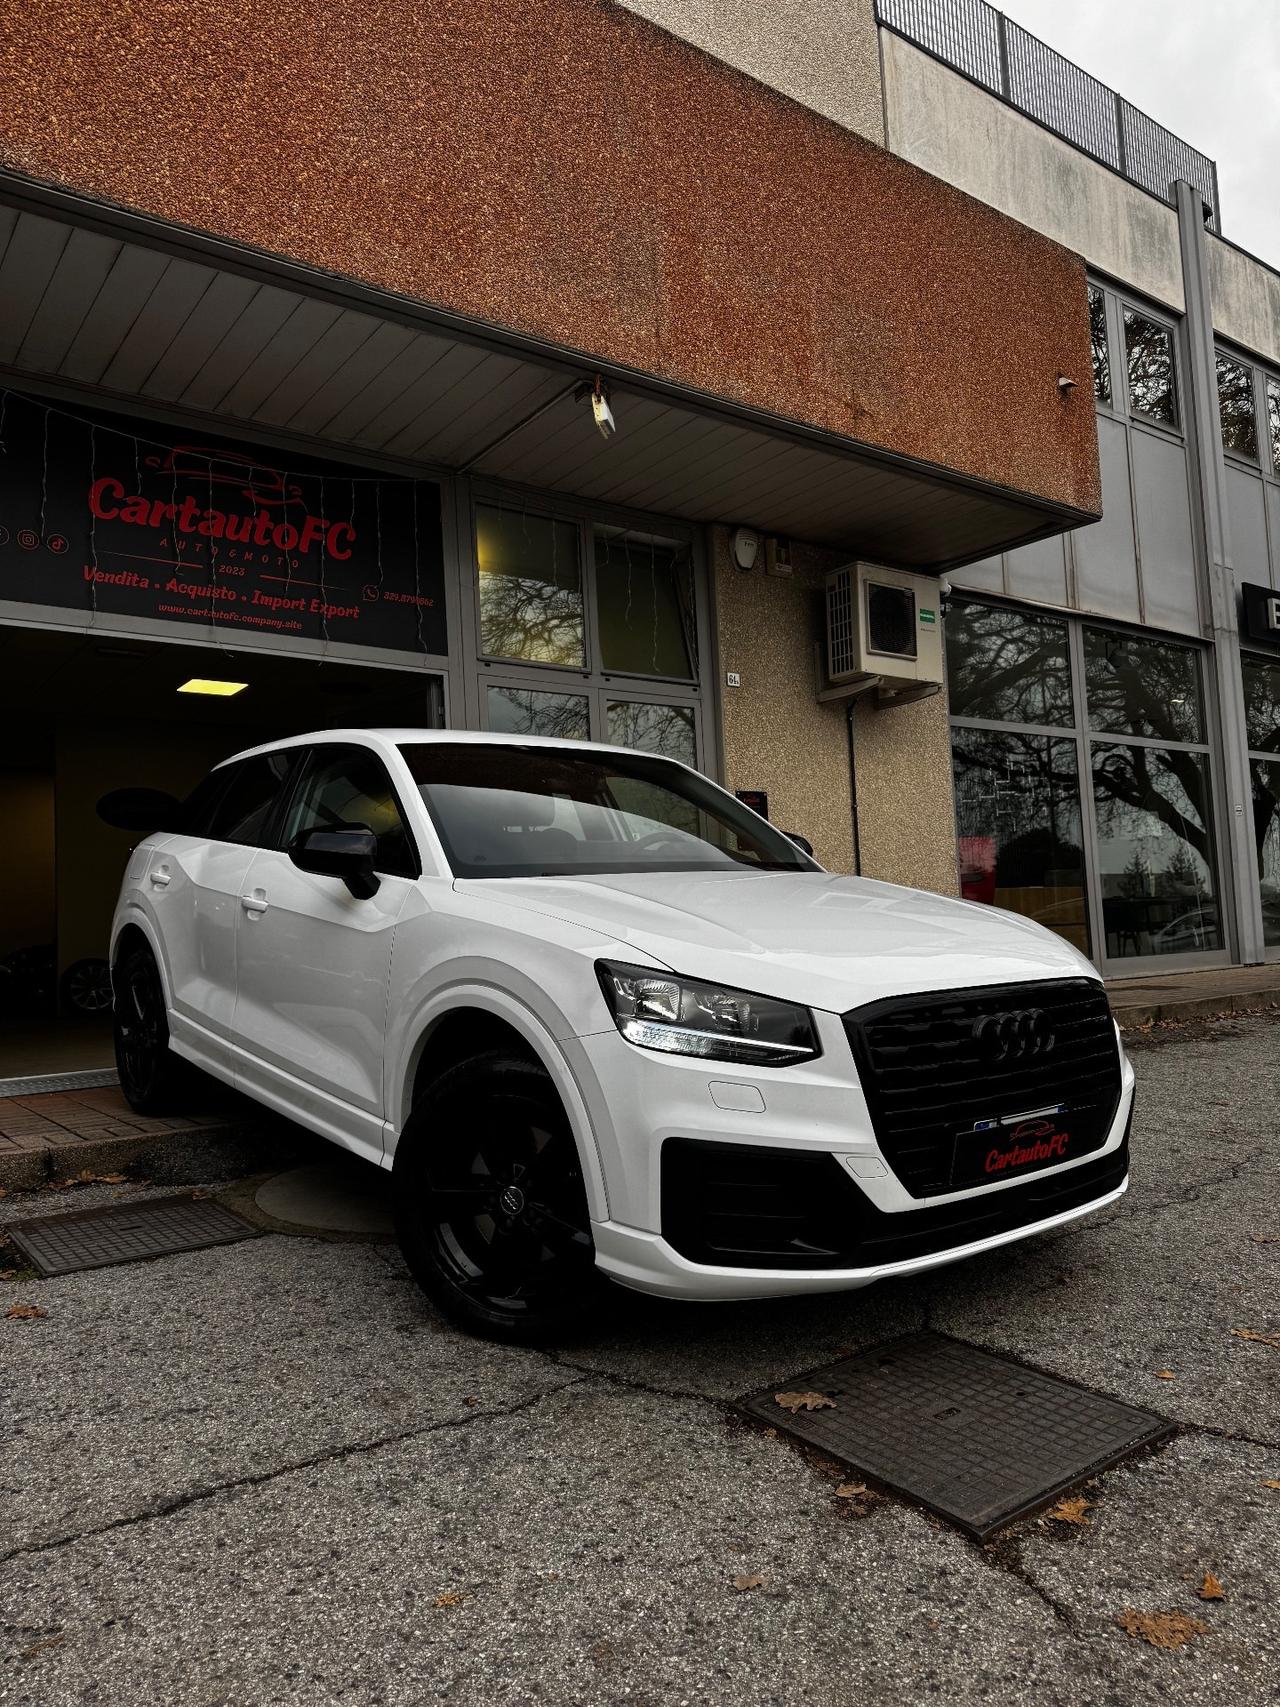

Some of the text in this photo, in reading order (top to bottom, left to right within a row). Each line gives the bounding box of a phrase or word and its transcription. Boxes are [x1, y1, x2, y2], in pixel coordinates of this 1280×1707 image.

[88, 477, 357, 560] CartautoFC
[83, 565, 360, 619] Vendita Acquisto Import Export
[218, 564, 247, 577] 2023
[984, 1132, 1069, 1173] CartautoFC
